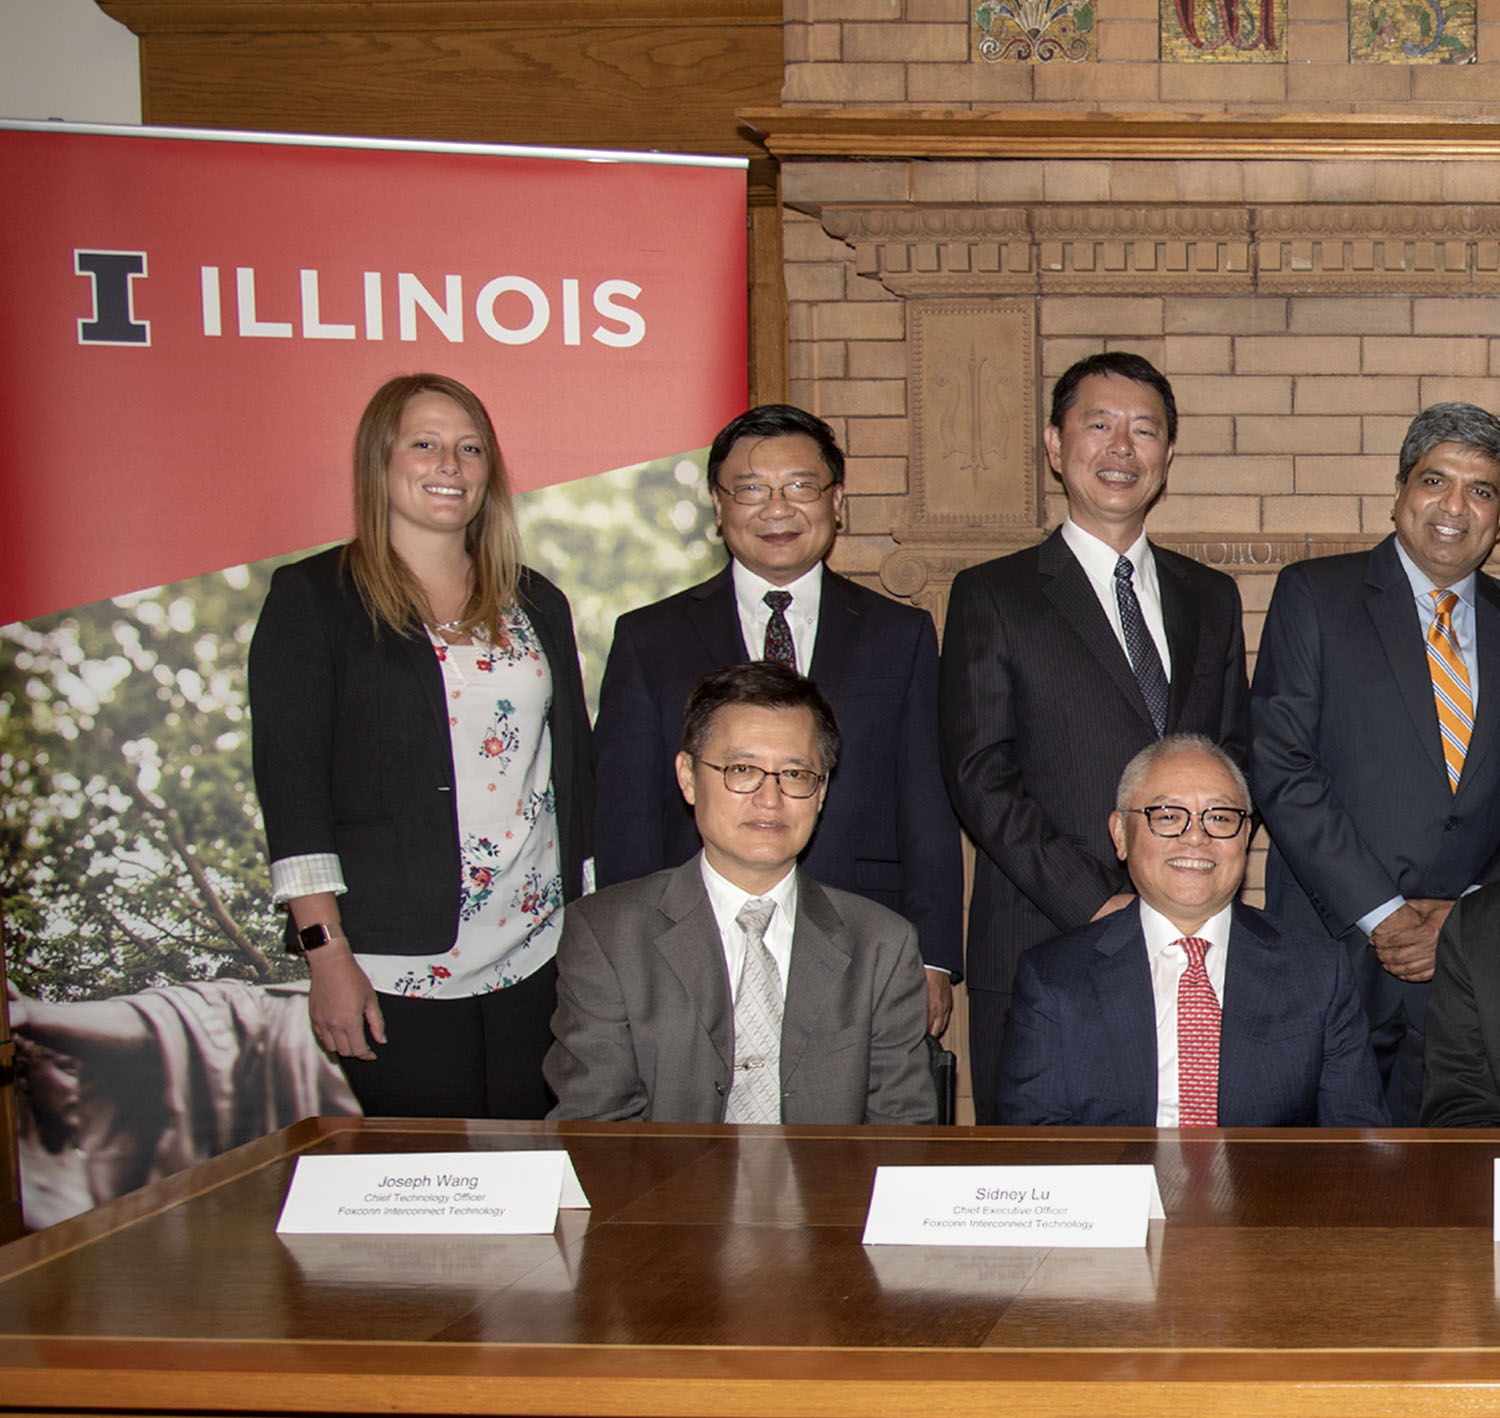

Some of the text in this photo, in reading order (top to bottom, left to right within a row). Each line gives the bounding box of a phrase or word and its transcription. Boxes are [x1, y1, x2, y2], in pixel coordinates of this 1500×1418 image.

[201, 265, 647, 348] ILLINOIS
[377, 1174, 480, 1190] Joseph Wang
[364, 1192, 487, 1204] Chief Technology Officer
[975, 1187, 1051, 1203] Sidney Lu
[337, 1206, 507, 1218] Foxconn Interconnect Technology
[953, 1206, 1069, 1215] Chief Executive Officer
[923, 1218, 1095, 1231] Foxconn Interconnect Technology
